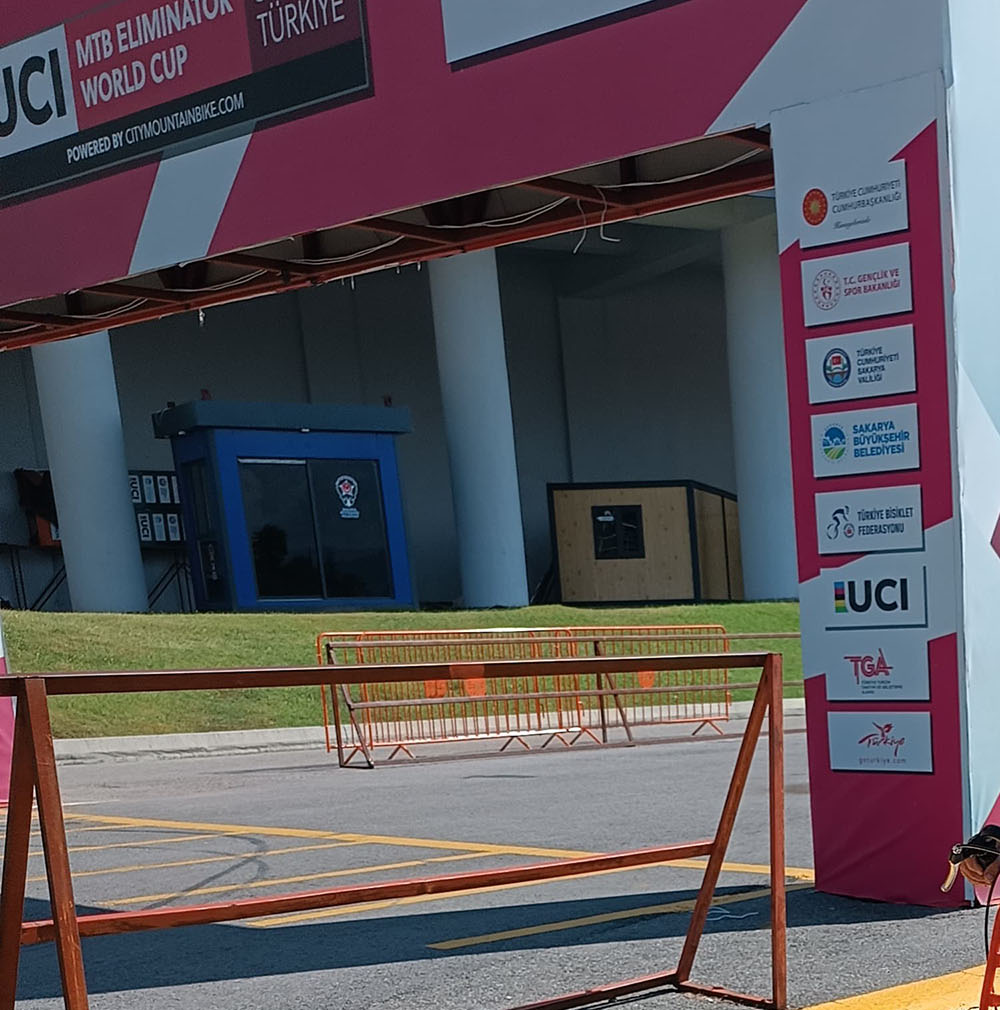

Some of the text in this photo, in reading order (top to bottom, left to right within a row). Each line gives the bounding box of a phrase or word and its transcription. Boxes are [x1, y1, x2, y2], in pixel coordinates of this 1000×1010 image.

[75, 29, 114, 68] MTB
[80, 45, 188, 108] WORLD CUP
[66, 92, 244, 164] POWERED BY CITYMOUNTAINBIKE.COM
[843, 268, 900, 286] T.C. GENÇLİK VE
[843, 279, 901, 297] SPOR BAKANLIĞI
[857, 365, 886, 375] SAKARYA
[852, 420, 896, 434] SAKARYA
[853, 430, 910, 446] BÜYÜKŞEHİR
[854, 442, 905, 457] BELEDİYESİ
[857, 506, 913, 521] TÜRKİYE BİSİKLET
[858, 523, 905, 536] FEDERASYONU
[848, 578, 908, 612] UCI
[843, 648, 893, 684] TGA
